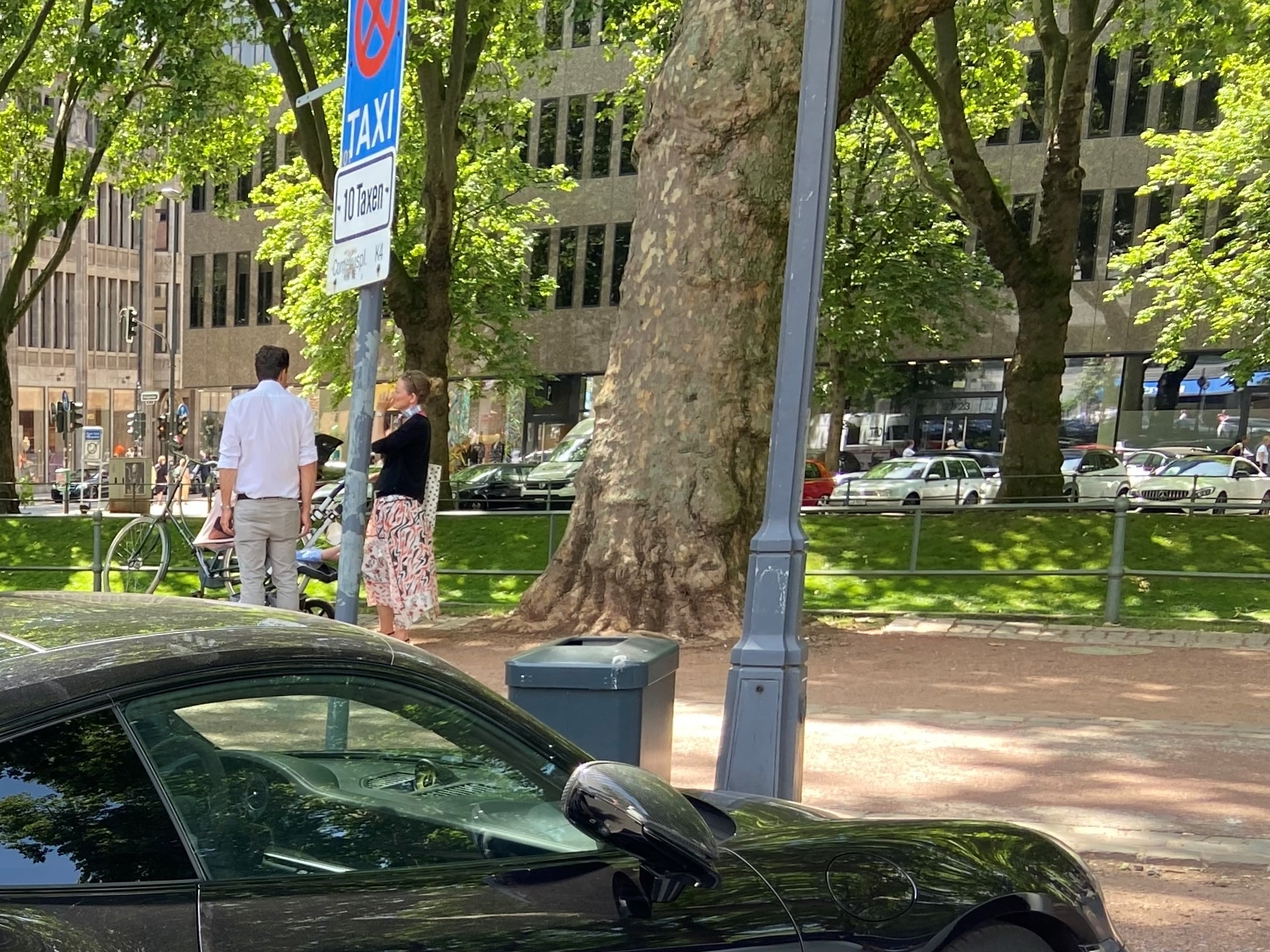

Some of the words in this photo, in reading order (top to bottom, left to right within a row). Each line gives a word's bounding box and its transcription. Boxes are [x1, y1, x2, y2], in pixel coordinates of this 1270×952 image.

[347, 88, 395, 159] TAXI
[343, 187, 355, 222] 10
[356, 183, 384, 217] Taxen
